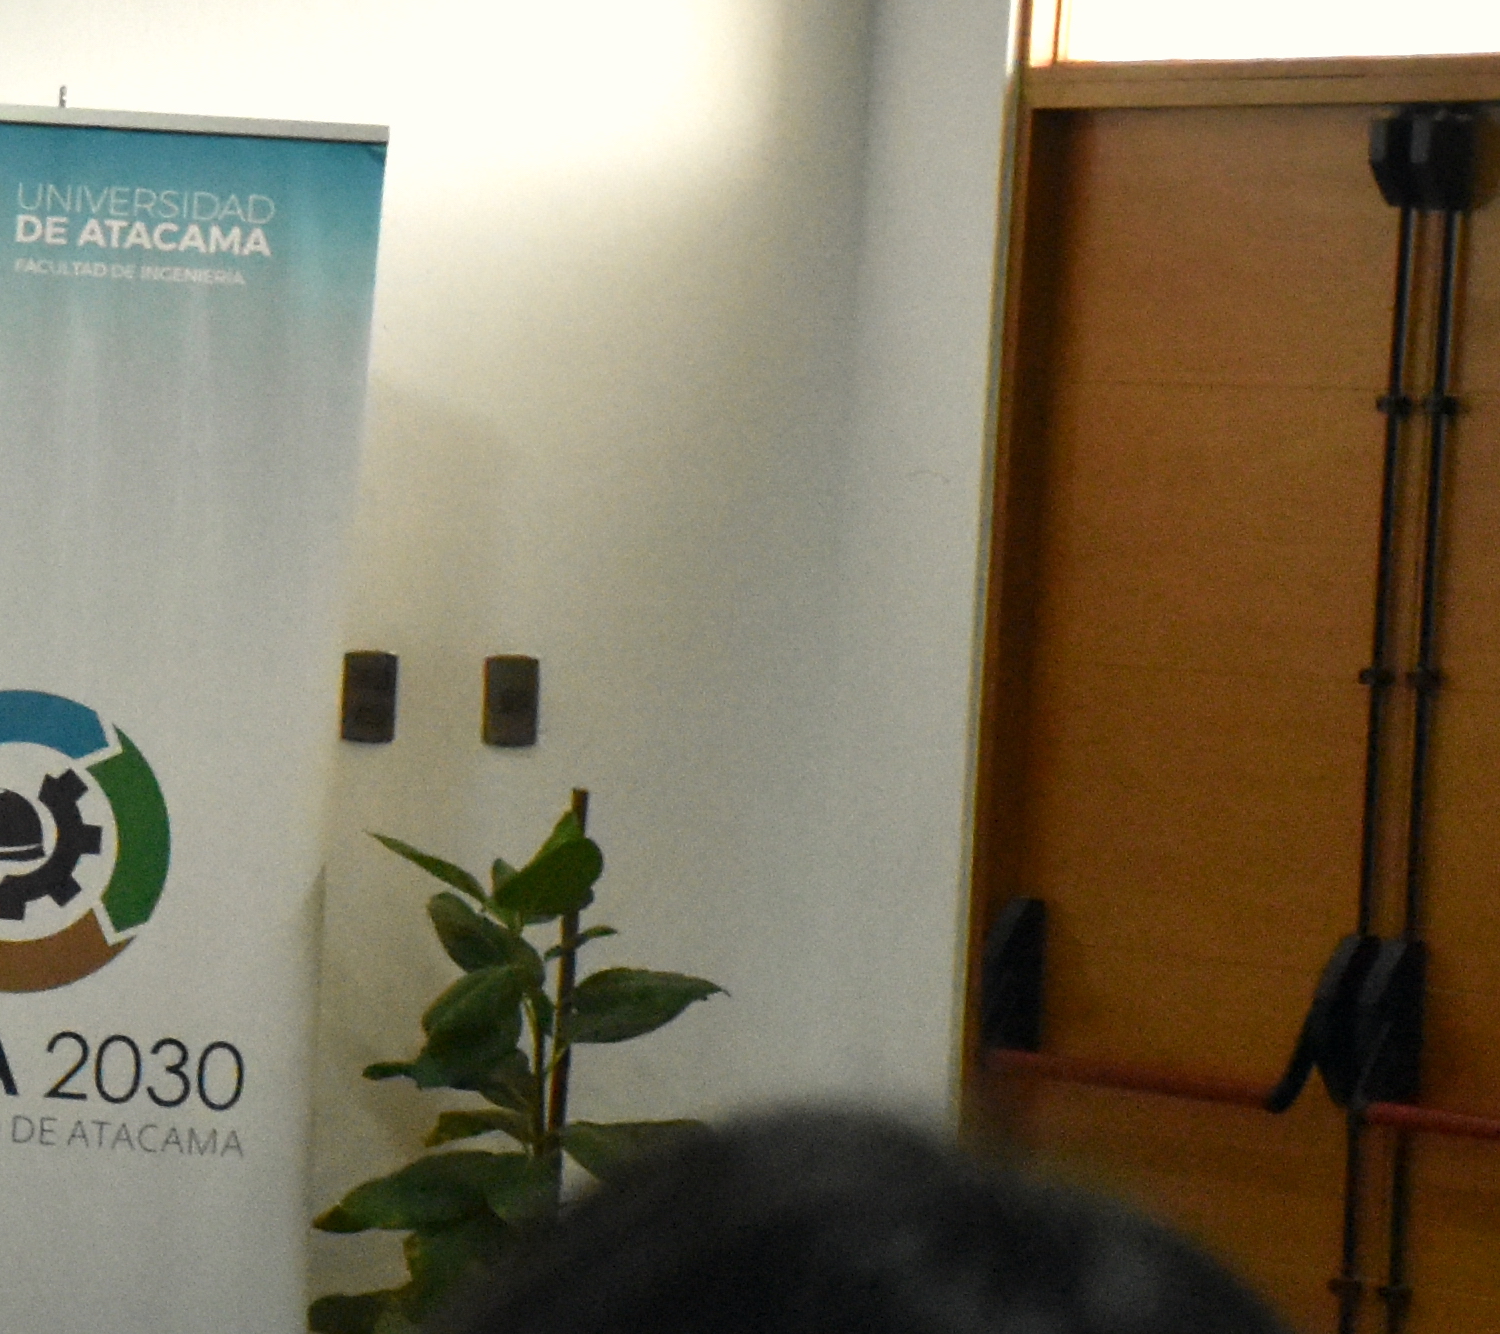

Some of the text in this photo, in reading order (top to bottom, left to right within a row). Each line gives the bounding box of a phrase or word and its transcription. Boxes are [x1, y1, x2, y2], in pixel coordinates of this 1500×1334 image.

[17, 182, 276, 224] UNIVERSIDAD
[14, 214, 271, 257] DE ATACAMA
[13, 257, 107, 278] FACULTAD
[110, 262, 134, 280] DE
[44, 1030, 245, 1112] 2030
[10, 1113, 57, 1148] DE
[65, 1119, 245, 1159] ATACAMA
